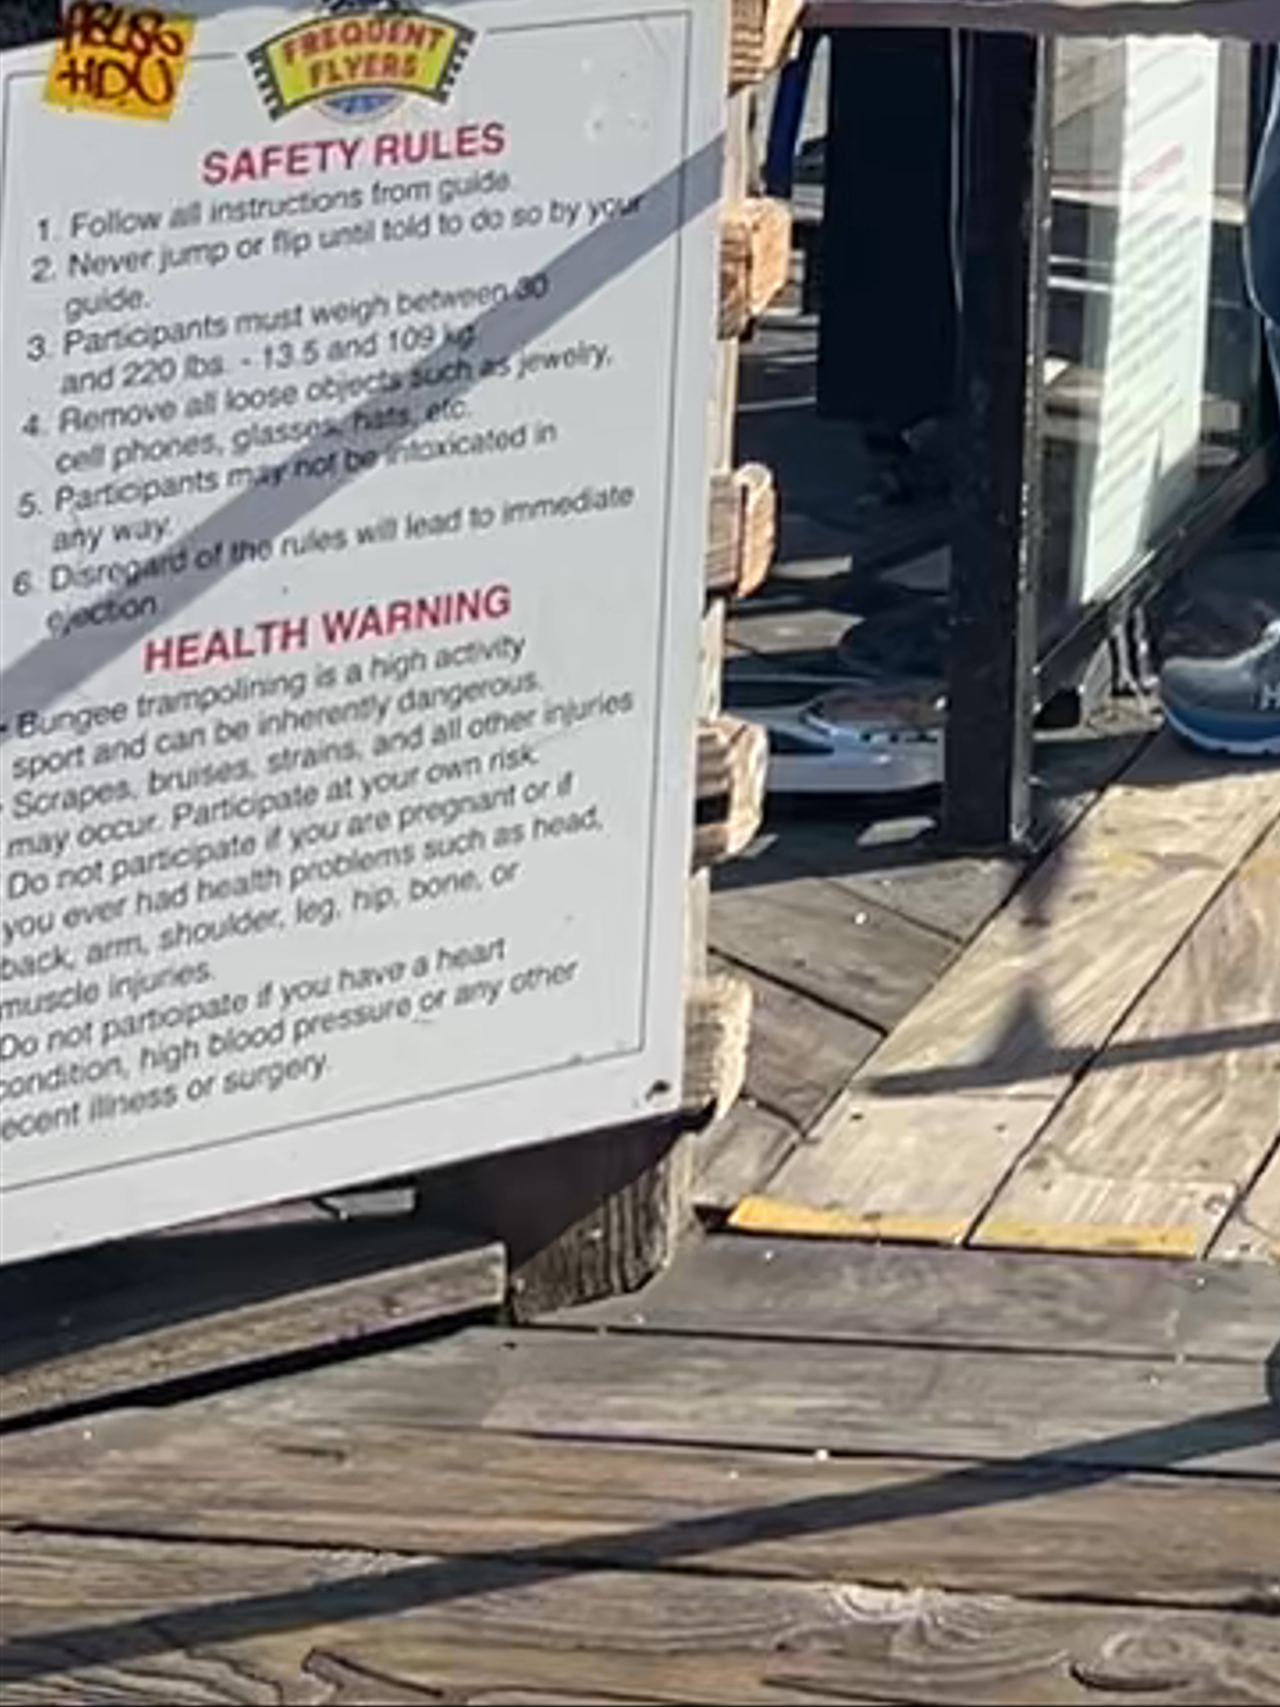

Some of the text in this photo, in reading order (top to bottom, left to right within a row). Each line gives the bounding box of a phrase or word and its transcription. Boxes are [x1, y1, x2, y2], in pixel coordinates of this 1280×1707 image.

[283, 21, 445, 66] FREQUENT
[309, 52, 418, 88] FLYERS
[202, 122, 505, 186] SAFETY RULES
[143, 584, 512, 673] HEALTH WARNING
